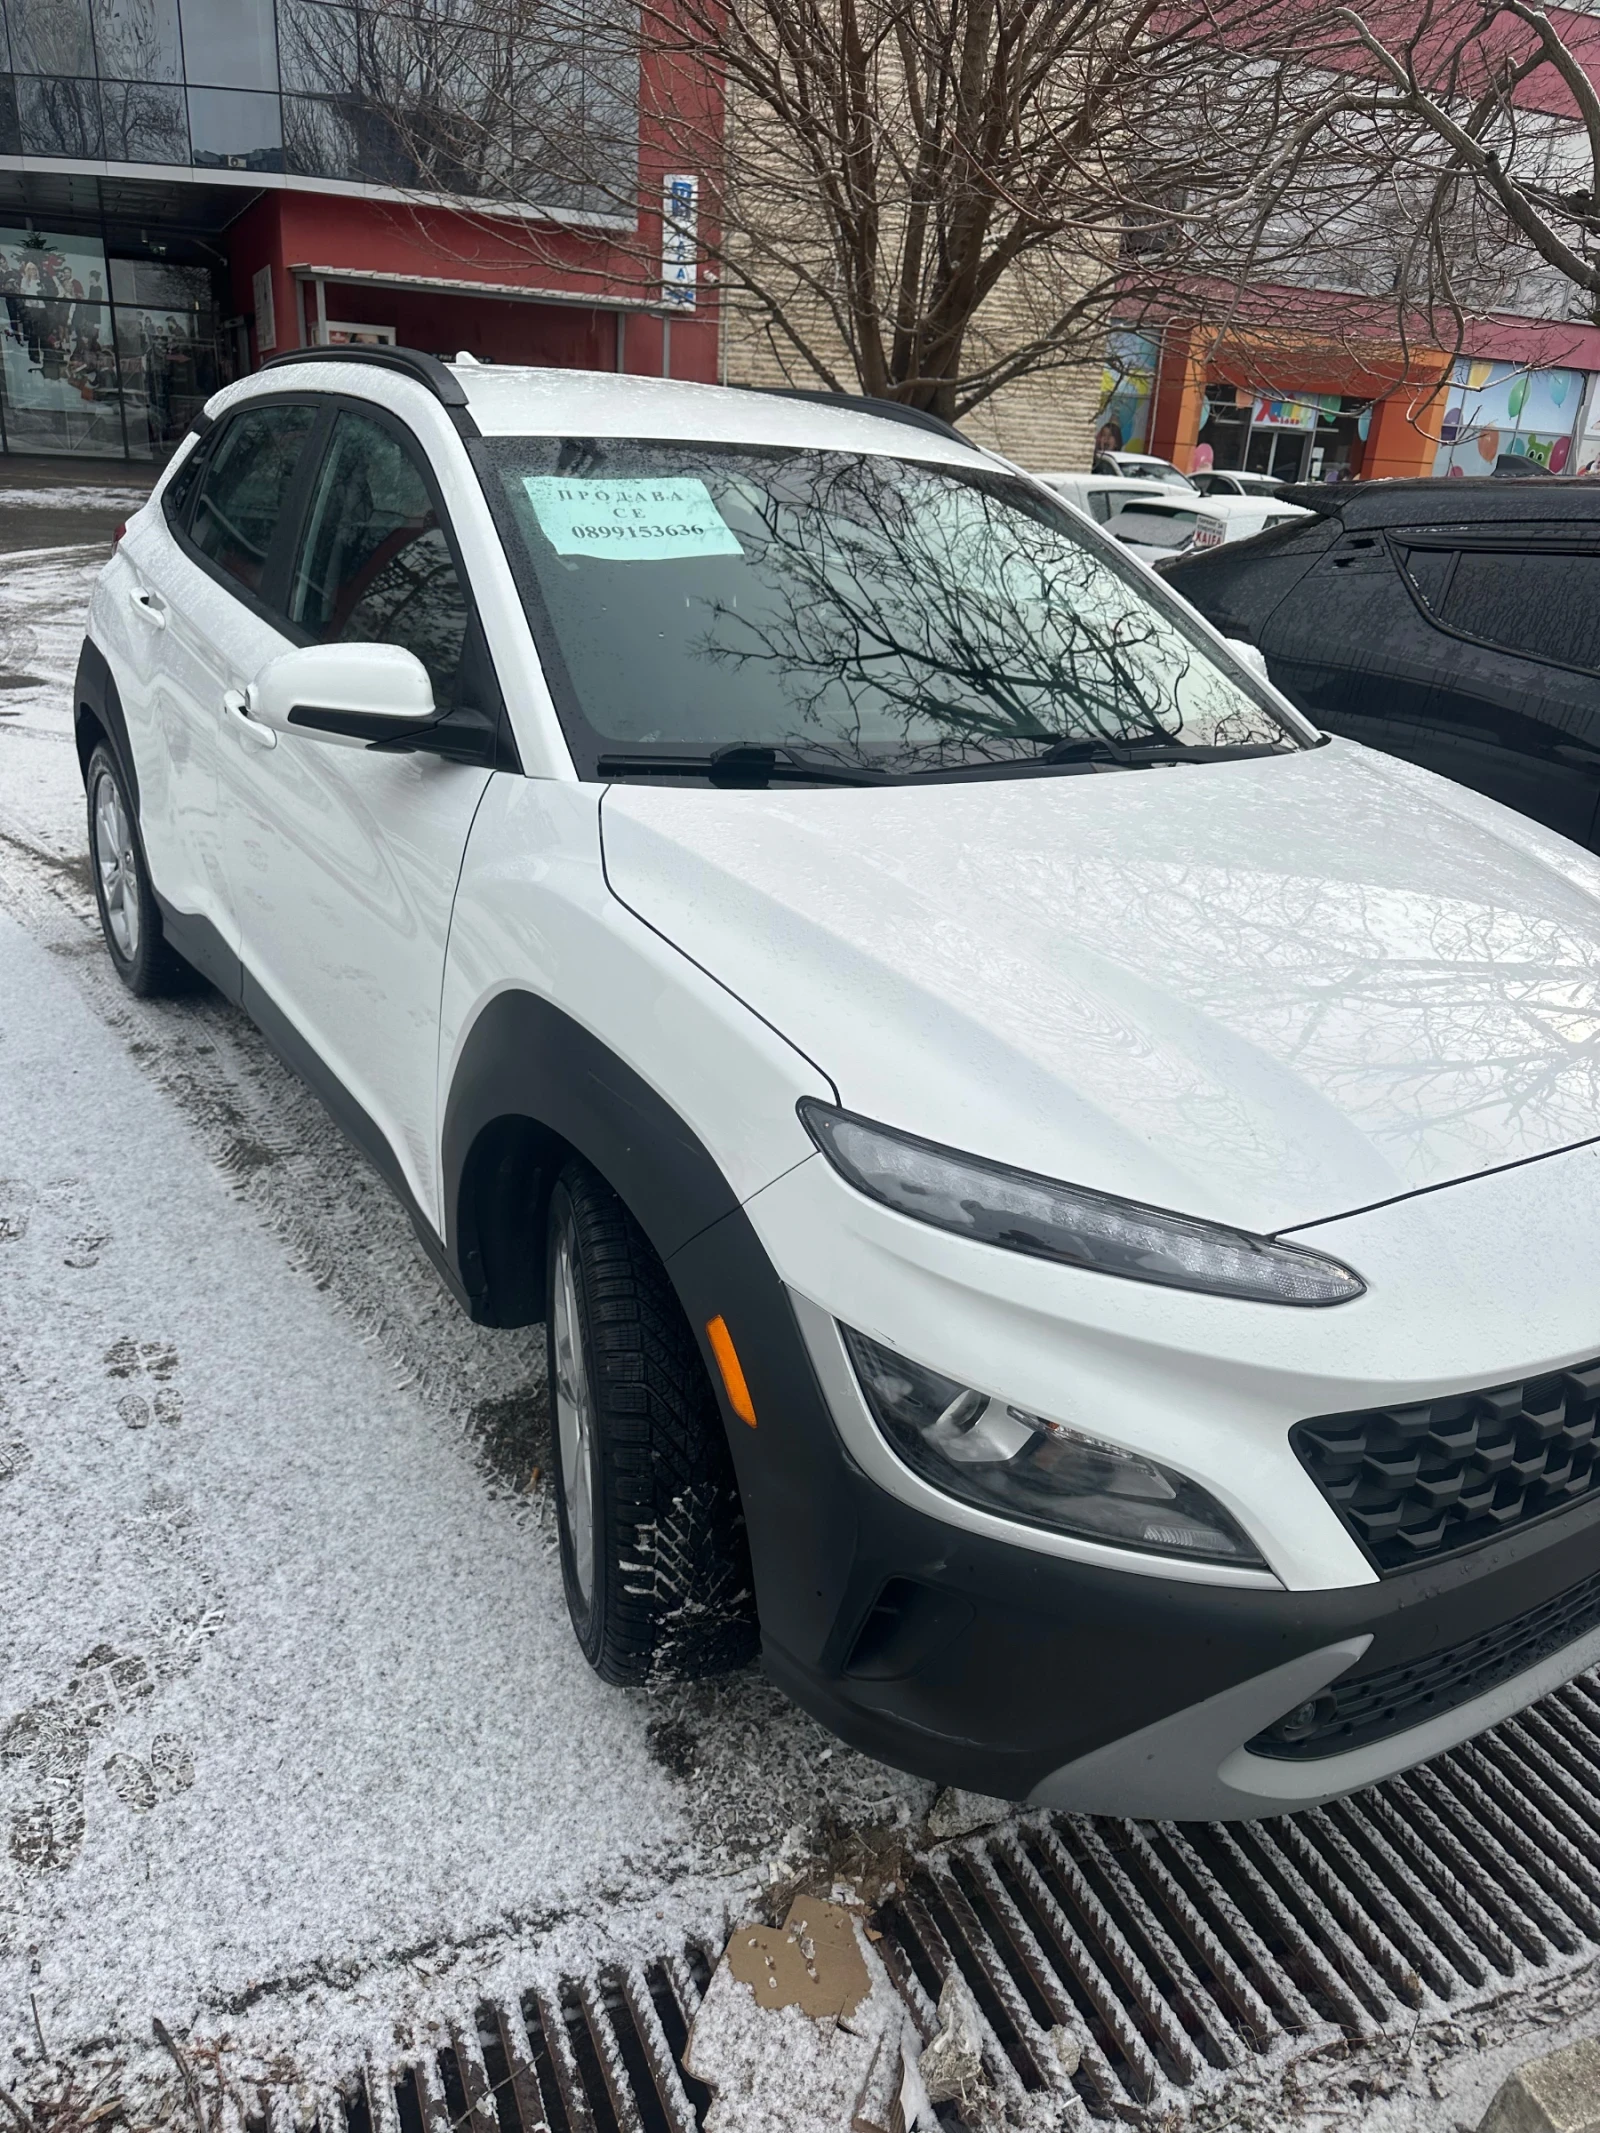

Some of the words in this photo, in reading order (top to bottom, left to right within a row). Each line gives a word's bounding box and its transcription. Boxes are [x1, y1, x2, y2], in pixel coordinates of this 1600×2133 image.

[557, 490, 685, 503] ПРОДАВА
[612, 508, 646, 519] СЕ
[571, 524, 704, 539] 0899153636
